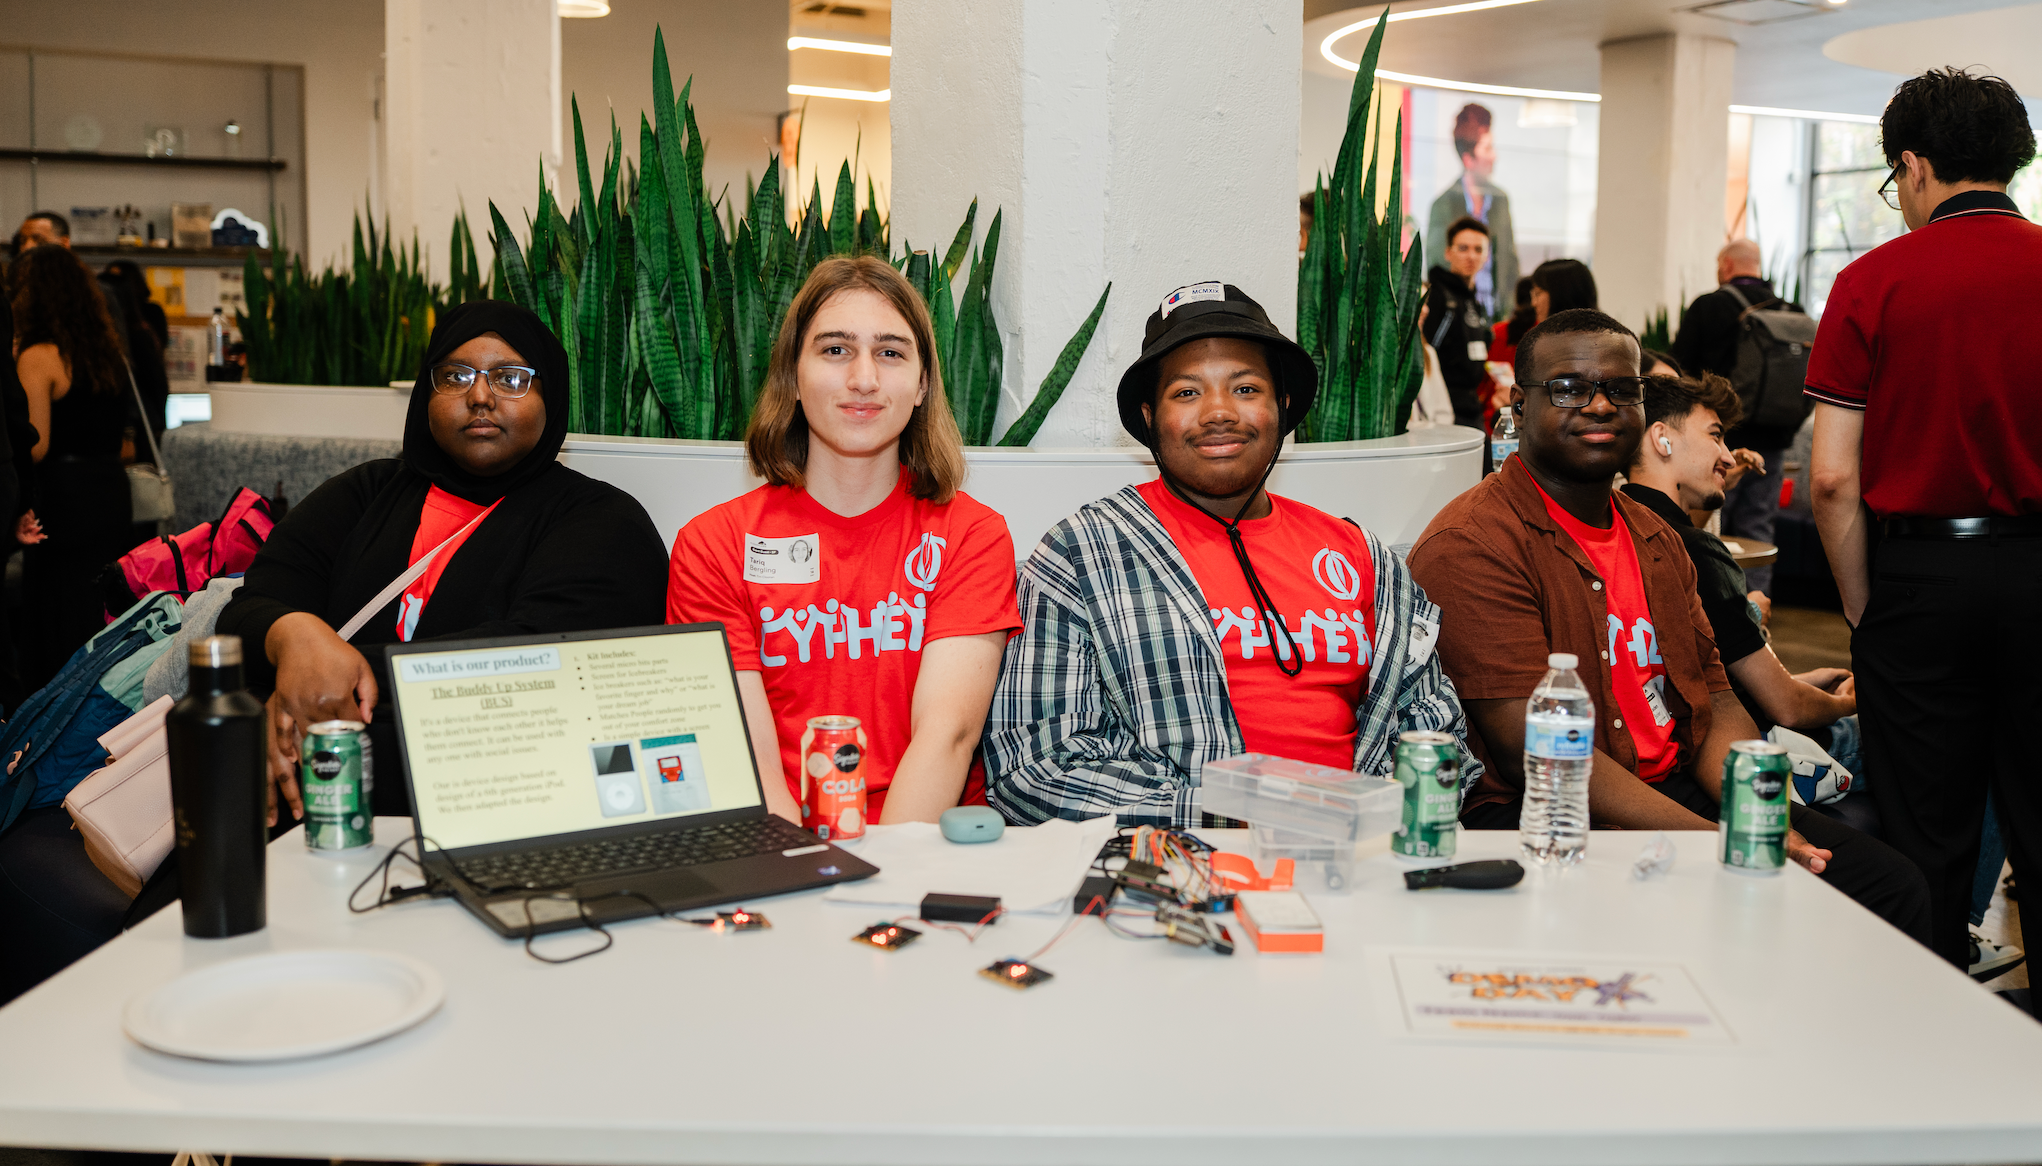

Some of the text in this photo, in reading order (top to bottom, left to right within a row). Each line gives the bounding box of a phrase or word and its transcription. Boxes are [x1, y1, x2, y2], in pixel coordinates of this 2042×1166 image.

[750, 556, 765, 566] Tariq
[750, 565, 776, 574] Bergling
[586, 650, 636, 660] Kit Includes:
[412, 653, 551, 675] What is our product?
[589, 662, 615, 671] Several
[651, 658, 669, 668] parts
[591, 672, 615, 681] Screen
[605, 680, 635, 689] breakers
[636, 678, 652, 686] such
[693, 674, 708, 683] your
[431, 679, 555, 699] The Buddy Up System
[595, 692, 622, 701] favorite
[624, 689, 644, 699] finger
[646, 688, 658, 696] and
[597, 703, 613, 711] your
[615, 700, 637, 708] dream
[599, 712, 629, 721] Matches
[630, 709, 654, 718] People
[655, 705, 687, 716] randomly
[697, 704, 707, 713] get
[708, 702, 721, 711] you
[443, 716, 470, 724] device
[473, 713, 490, 722] that
[492, 710, 528, 720] connects
[530, 707, 557, 717] people
[422, 729, 441, 738] who
[468, 725, 490, 735] know
[493, 722, 512, 731] each
[514, 720, 536, 729] other
[546, 716, 568, 727] helps
[623, 720, 639, 730] your
[641, 717, 668, 726] comfort
[424, 742, 446, 752] them
[525, 730, 545, 740] used
[546, 729, 565, 738] with
[618, 731, 641, 741] simple
[666, 726, 682, 734] with
[426, 755, 442, 764] any
[444, 753, 461, 762] one
[463, 750, 483, 760] with
[485, 746, 509, 756] social
[462, 776, 489, 787] device
[491, 774, 518, 785] design
[520, 770, 544, 780] based
[822, 777, 866, 795] COLA
[305, 783, 352, 796] GINGER
[435, 792, 463, 804] design
[500, 783, 542, 796] generation
[314, 796, 340, 806] ALE
[454, 803, 473, 813] then
[475, 799, 507, 812] adapted
[509, 797, 522, 806] the
[1755, 816, 1777, 826] ALE
